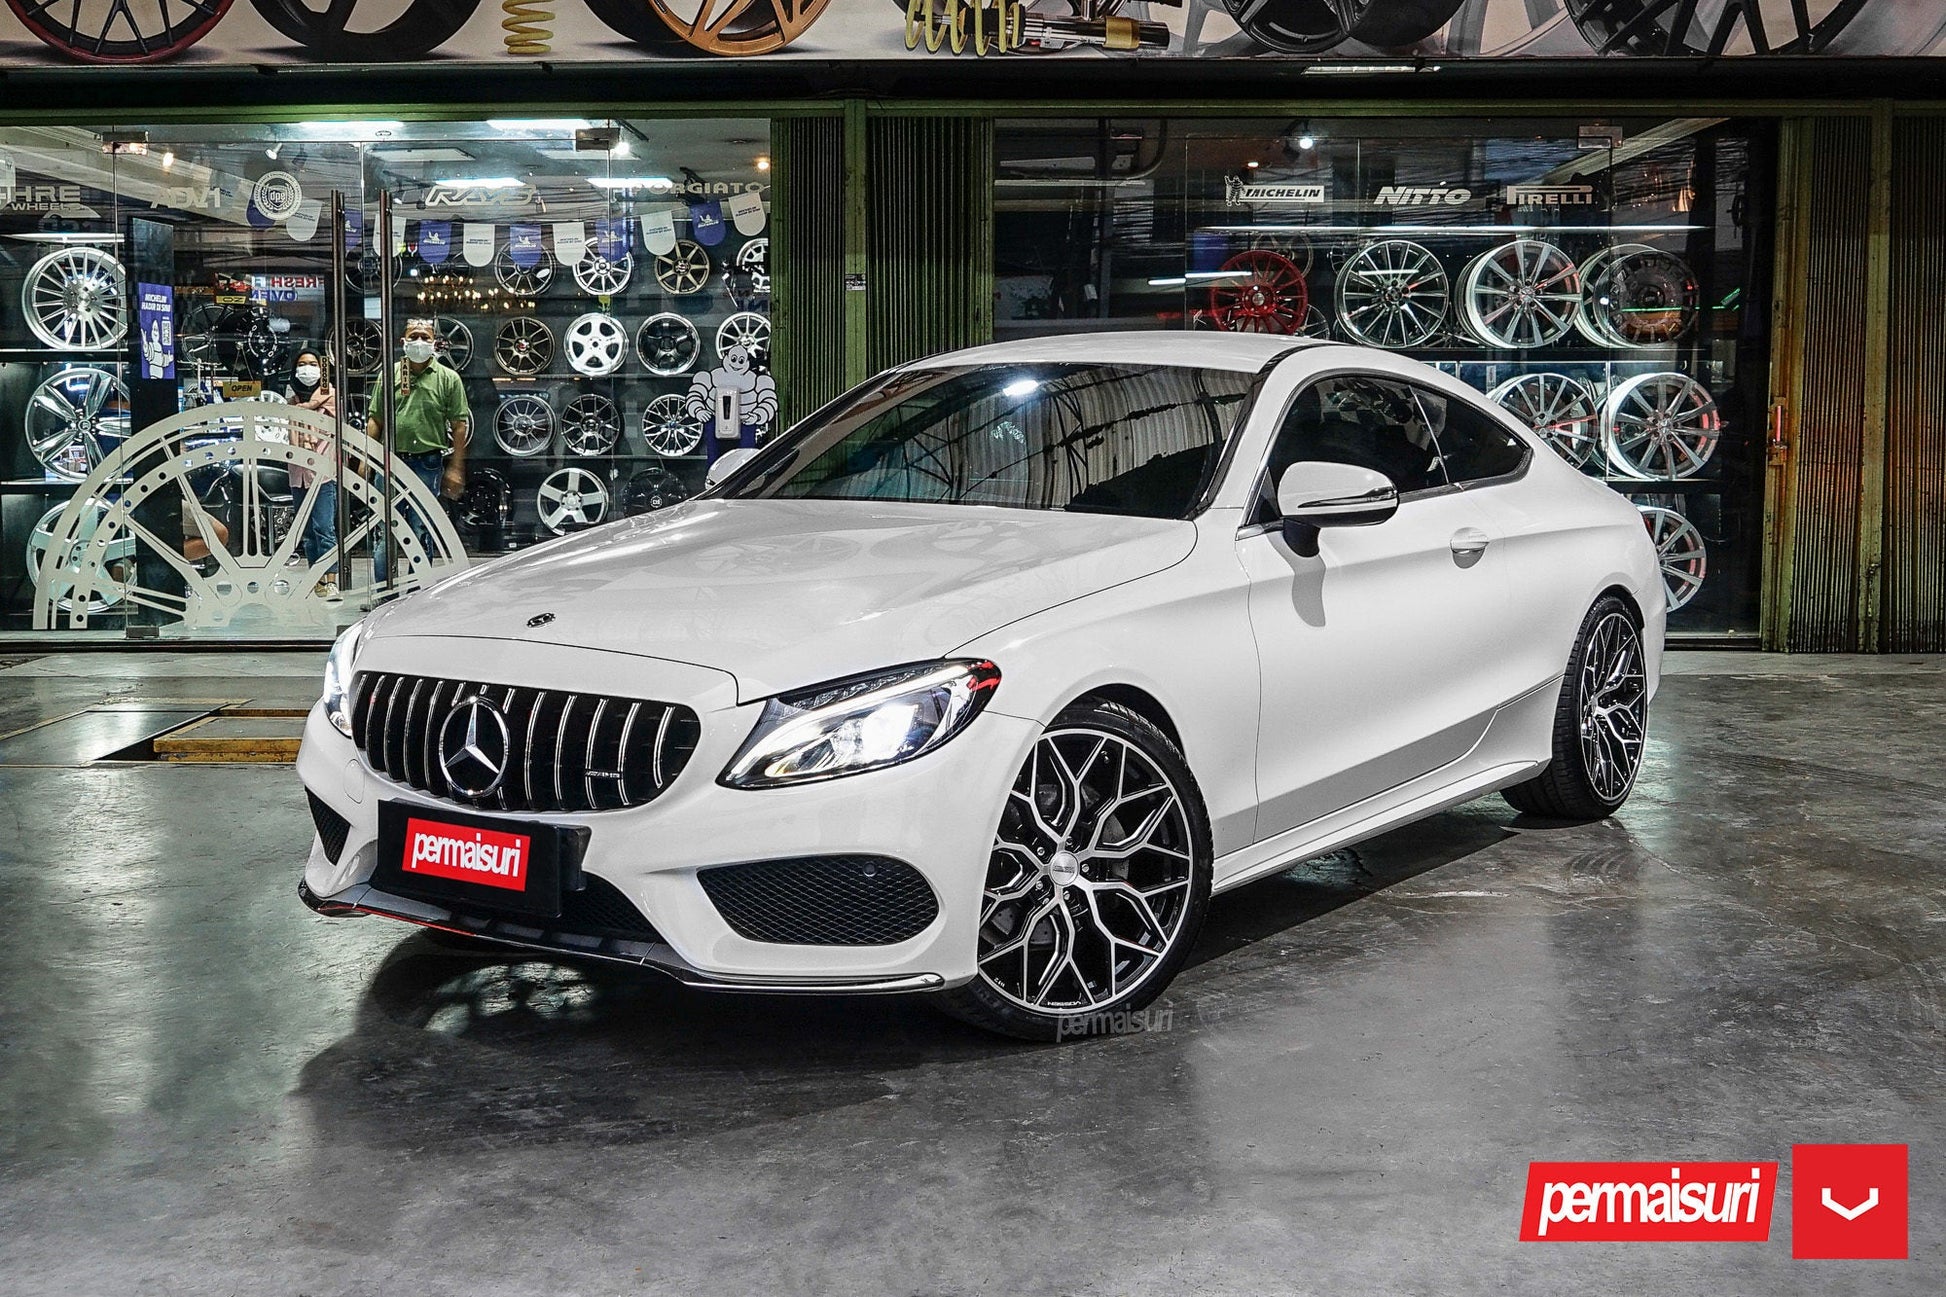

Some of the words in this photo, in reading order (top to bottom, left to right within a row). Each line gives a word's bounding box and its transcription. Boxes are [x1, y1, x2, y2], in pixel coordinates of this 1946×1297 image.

[11, 186, 80, 202] HRE
[270, 191, 286, 204] dpe
[1245, 188, 1321, 198] MICHELIN
[1374, 186, 1472, 205] NITTO
[1507, 185, 1593, 204] PIRELLI
[231, 384, 253, 392] OPEN
